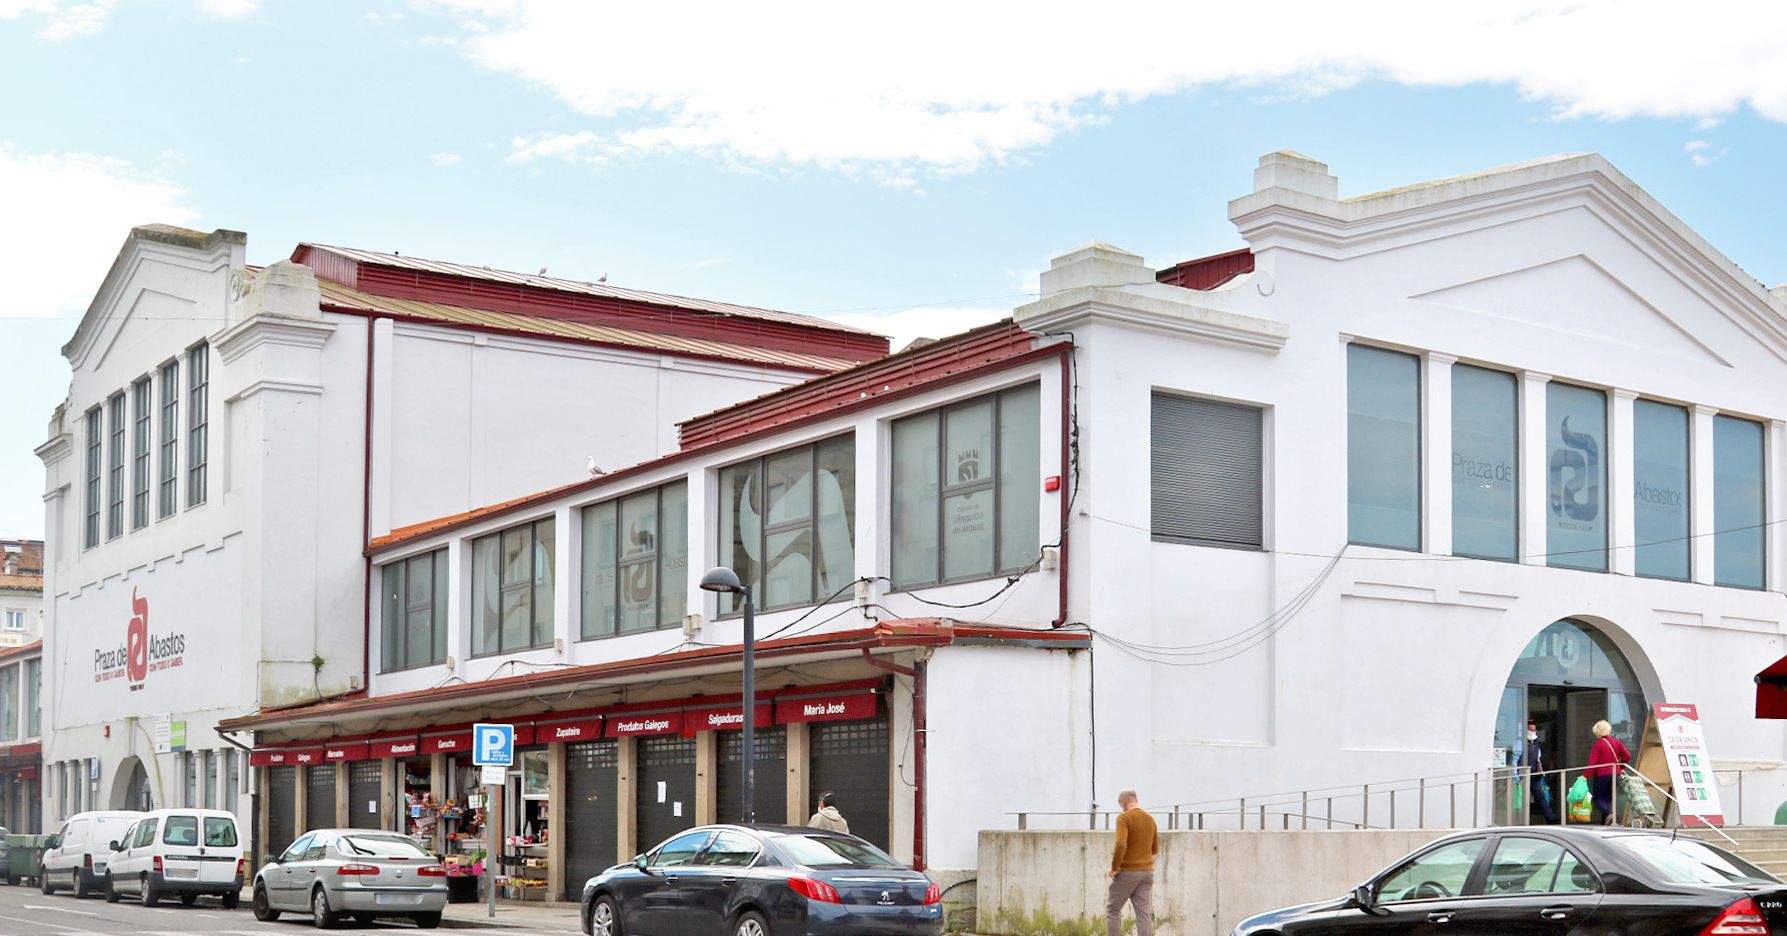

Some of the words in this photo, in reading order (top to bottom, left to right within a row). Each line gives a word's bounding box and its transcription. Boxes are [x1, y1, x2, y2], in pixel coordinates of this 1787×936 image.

[1452, 452, 1494, 480] Praza
[95, 648, 115, 672] Praza
[117, 643, 127, 667] de
[149, 631, 185, 661] Abastos
[826, 702, 846, 714] José
[617, 722, 643, 732] Produtos
[644, 719, 669, 731] Galegos
[708, 713, 743, 726] Salgaduras
[556, 727, 580, 738] Zapateiro
[482, 729, 506, 761] P
